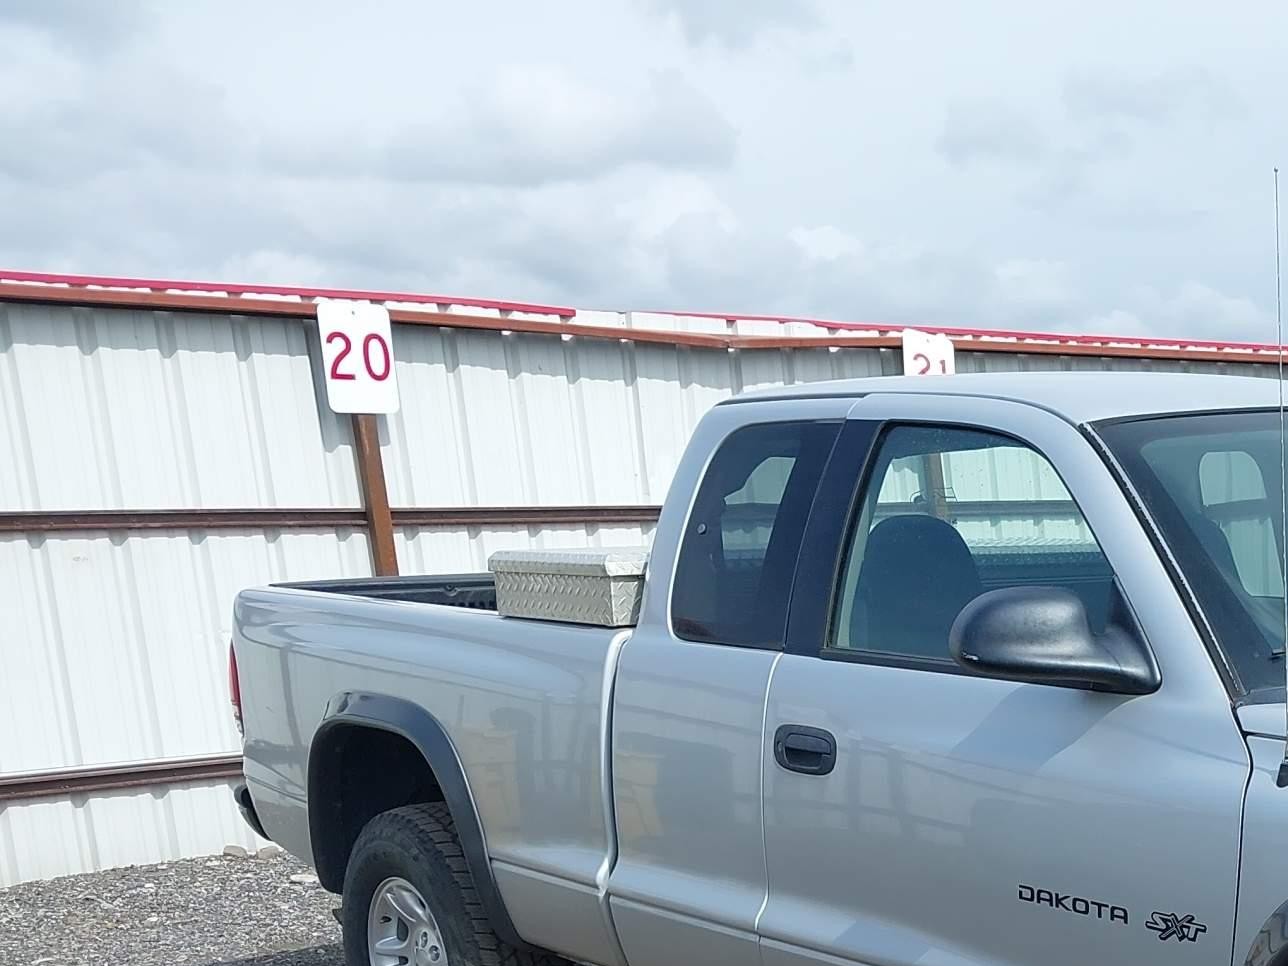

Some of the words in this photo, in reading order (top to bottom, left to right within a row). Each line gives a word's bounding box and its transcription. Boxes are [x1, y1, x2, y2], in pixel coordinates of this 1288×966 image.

[325, 330, 391, 382] 20
[1018, 884, 1129, 925] DAKOTA
[1145, 911, 1207, 943] SXT
